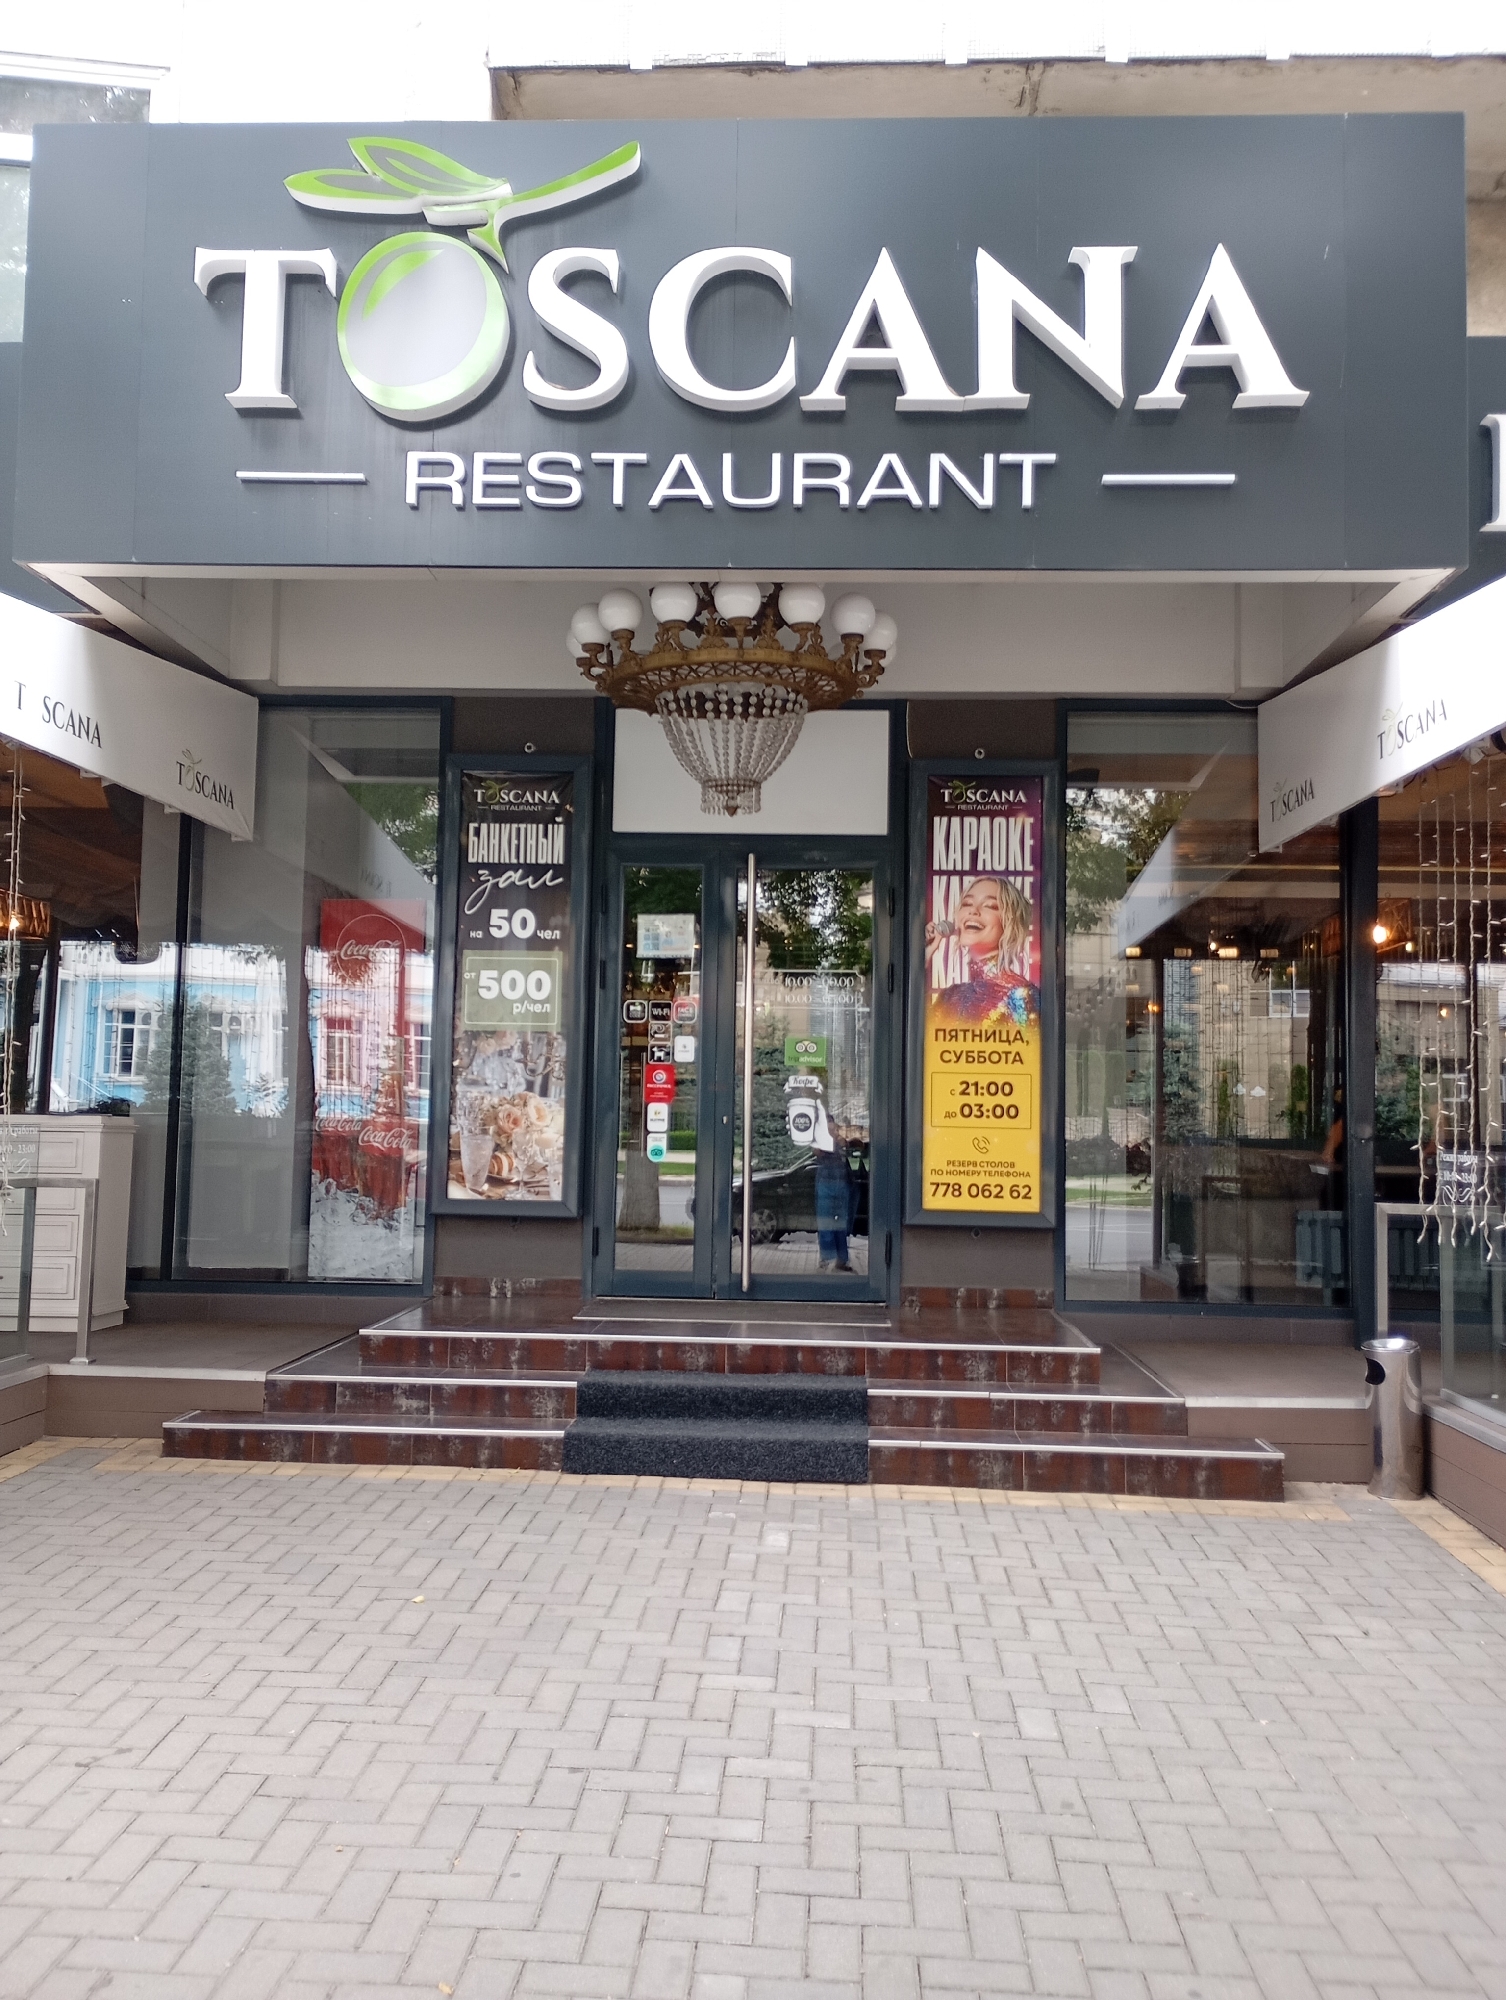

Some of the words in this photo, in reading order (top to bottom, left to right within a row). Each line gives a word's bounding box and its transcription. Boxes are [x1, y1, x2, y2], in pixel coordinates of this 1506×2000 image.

[193, 232, 1310, 422] TOSCANA
[405, 450, 1057, 510] RESTAURANT
[14, 680, 103, 749] TSCANA
[1377, 698, 1448, 760] TOSCANA
[176, 760, 235, 810] TOSCANA
[474, 787, 560, 804] TOSCANA
[940, 788, 1027, 804] TOSCANA
[1270, 777, 1315, 822] TOSCANA
[468, 817, 565, 865] БАНКЕТНЫЙ
[932, 816, 1035, 871] КАРАОКЕ
[464, 868, 564, 915] зал
[470, 930, 483, 939] на
[488, 908, 536, 939] 50
[537, 929, 560, 940] чел
[477, 969, 551, 1000] 500
[512, 1001, 551, 1016] р/чел
[934, 1028, 1030, 1046] ПЯТНИЦА,
[788, 1055, 823, 1063] tripadvisor
[939, 1050, 1024, 1065] СУББОТА
[793, 1077, 814, 1086] Кофе
[958, 1080, 1014, 1097] 21:00
[944, 1110, 957, 1119] до
[959, 1103, 1019, 1119] 03:00
[358, 1126, 413, 1151] Coca-Cola
[946, 1160, 978, 1168] РЕЗЕРВ
[979, 1160, 1016, 1169] СТОЛОВ
[983, 1170, 1031, 1178] ТЕЛЕФОНА
[930, 1182, 962, 1198] 778
[967, 1183, 1004, 1199] 062
[1009, 1184, 1032, 1200] 62
